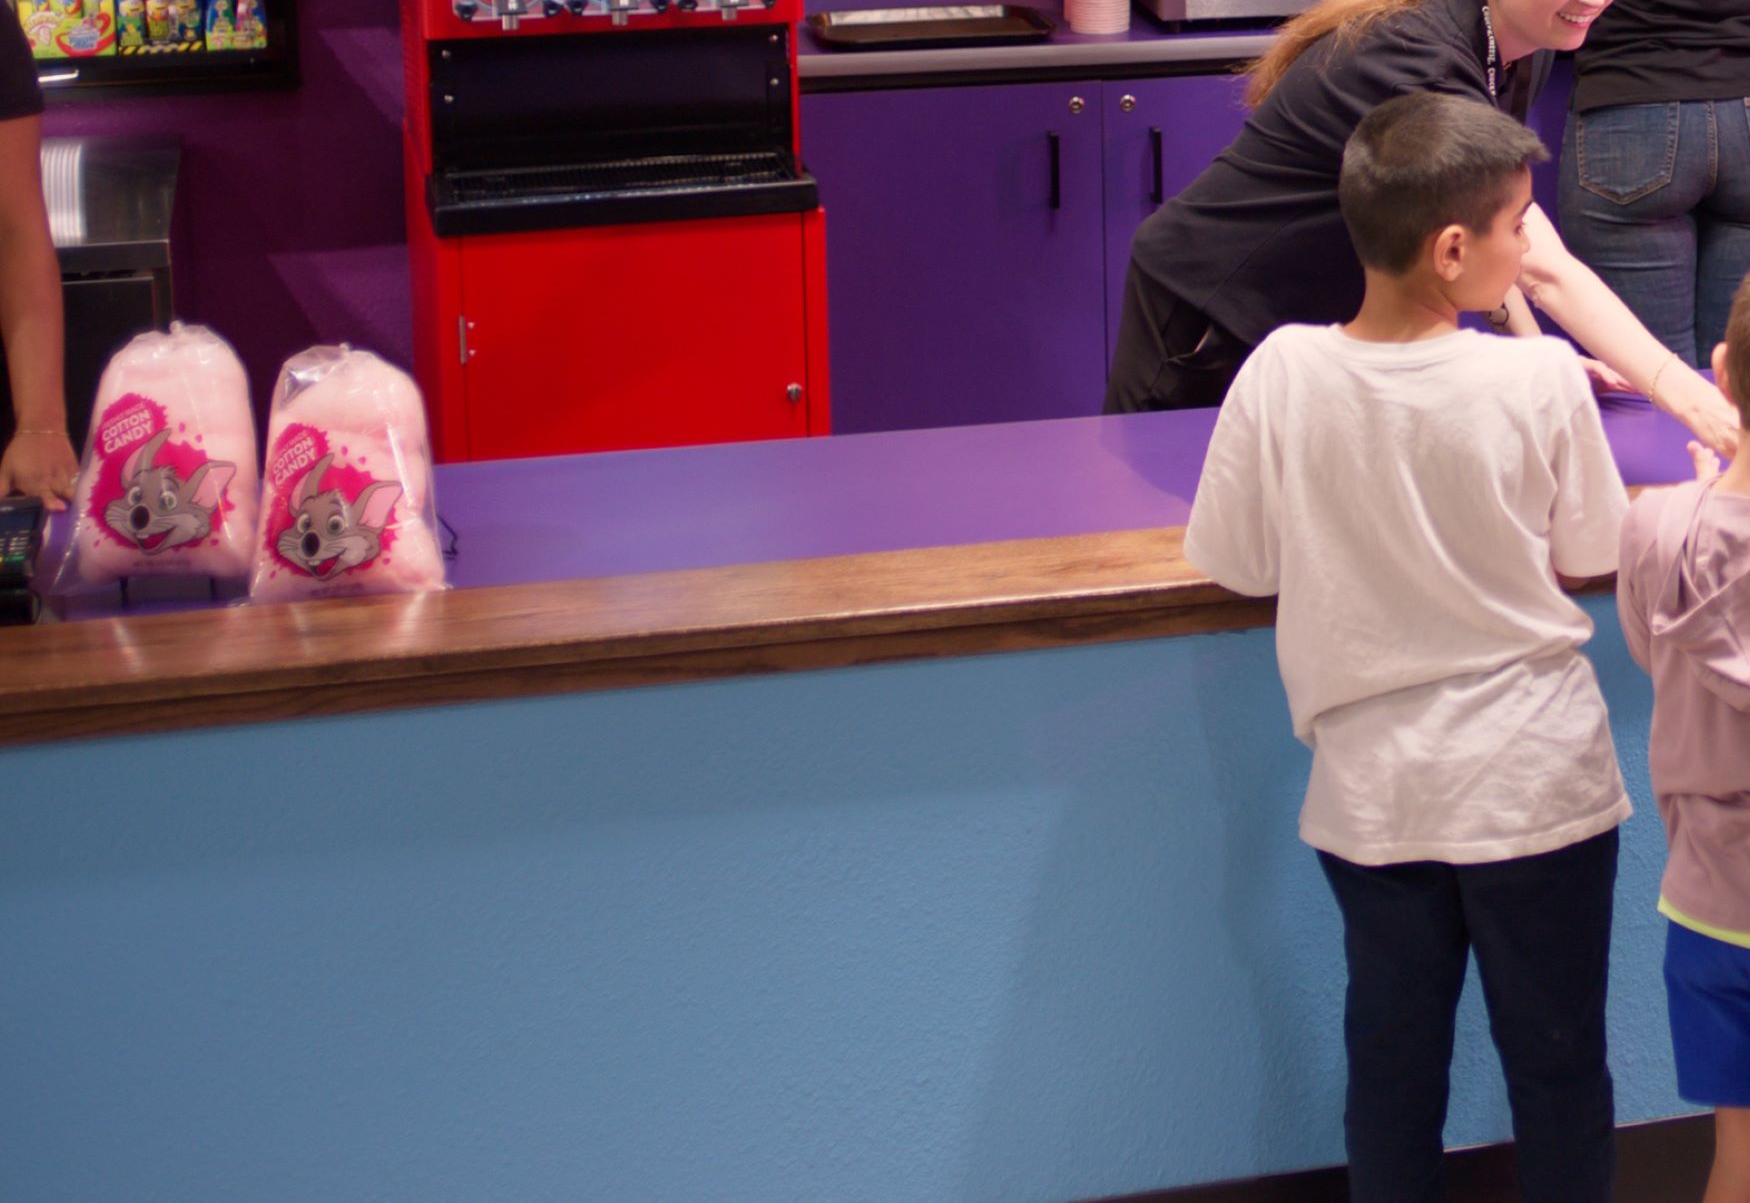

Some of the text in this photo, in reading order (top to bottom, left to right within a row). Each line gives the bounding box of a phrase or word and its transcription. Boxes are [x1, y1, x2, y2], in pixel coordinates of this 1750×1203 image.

[102, 409, 150, 441] COTTON
[104, 420, 152, 453] CANDY
[273, 436, 313, 475] COTTON
[275, 447, 316, 486] CANDY
